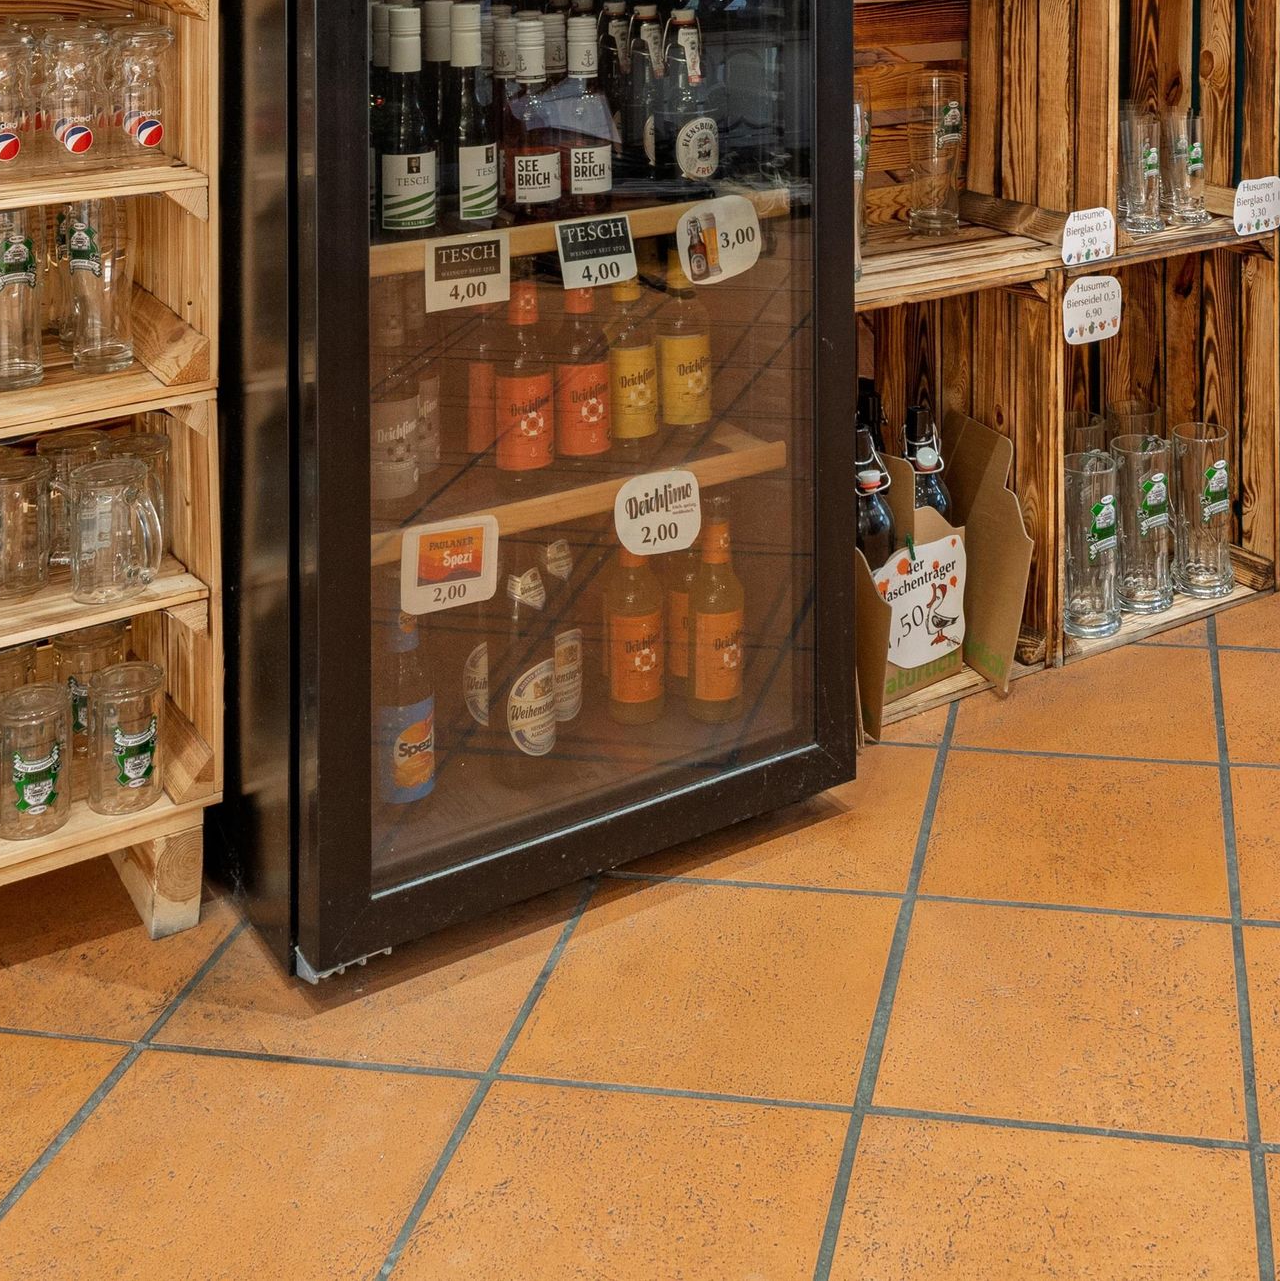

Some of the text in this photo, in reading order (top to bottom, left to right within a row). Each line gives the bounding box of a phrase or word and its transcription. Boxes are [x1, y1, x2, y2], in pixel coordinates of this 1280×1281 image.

[574, 151, 595, 164] SEE
[517, 159, 539, 172] SEE
[574, 163, 605, 178] BRICH
[395, 175, 429, 187] TESCH
[517, 172, 551, 187] BRICH
[1243, 181, 1274, 192] Husumer
[1237, 195, 1263, 207] Bierglas
[1073, 209, 1105, 222] Husumer
[563, 221, 625, 244] TESCH
[1066, 224, 1094, 237] Bierglas
[1095, 222, 1107, 231] 0,5
[720, 226, 755, 250] 3,00
[1081, 237, 1097, 248] 3,90
[439, 244, 496, 264] TESCH
[581, 261, 620, 284] 4,00
[449, 281, 487, 303] 4,00
[1076, 280, 1110, 293] Husumer
[1067, 291, 1116, 309] Bierseidel 0,5
[1085, 308, 1102, 319] 6,90
[625, 483, 693, 520] Deichlimo
[641, 522, 678, 546] 2,00
[429, 536, 474, 551] PAULANER
[443, 550, 473, 569] Spezi
[907, 559, 925, 576] 4er
[433, 584, 467, 605] 2,00
[889, 605, 925, 648] ,50
